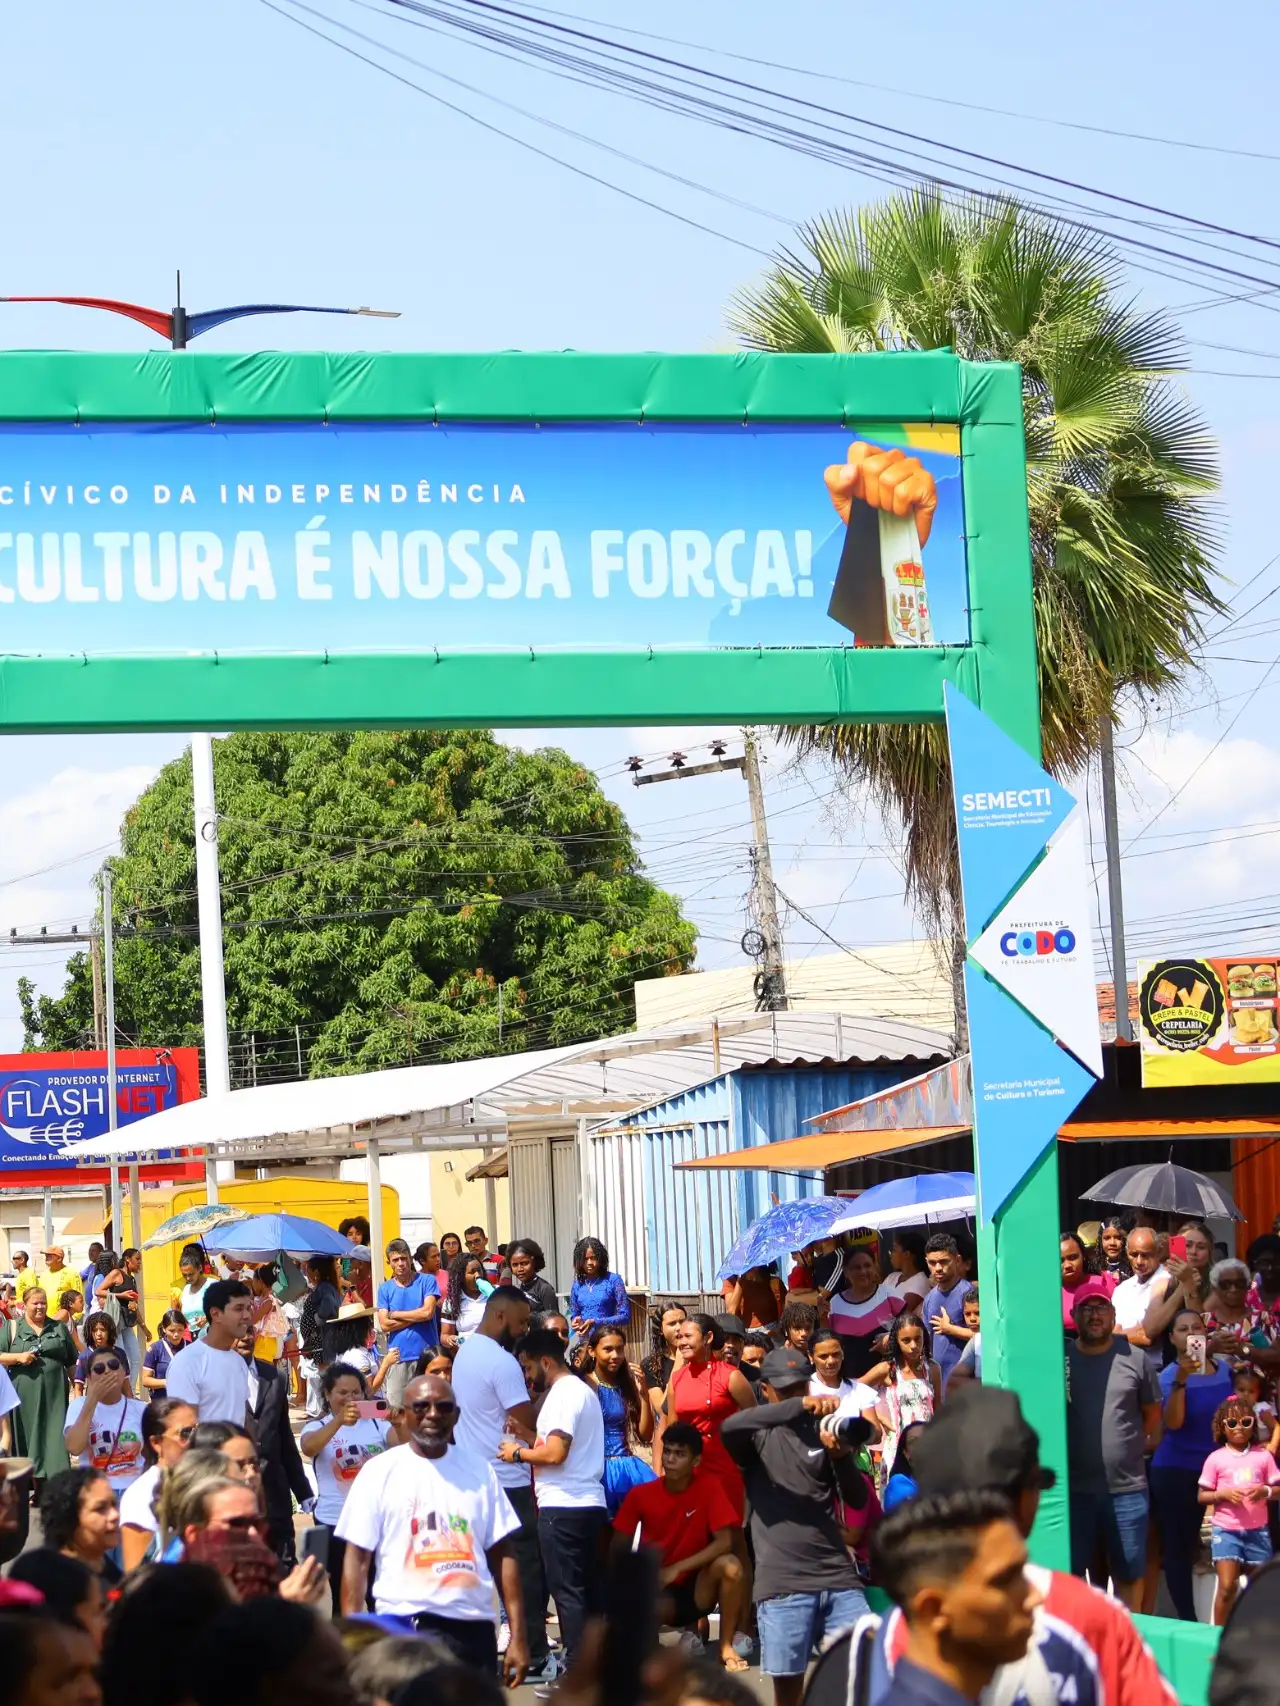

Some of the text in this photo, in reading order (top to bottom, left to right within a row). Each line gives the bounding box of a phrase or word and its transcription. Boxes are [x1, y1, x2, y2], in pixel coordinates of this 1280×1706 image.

[154, 484, 196, 504] DA
[220, 479, 526, 504] INDEPENDÊNCIA
[294, 514, 333, 600] É
[351, 529, 572, 600] NOSSA
[590, 529, 814, 616] FORÇA!
[962, 788, 1051, 811] SEMECTI
[1000, 925, 1076, 957] CODÓ
[1152, 1009, 1176, 1022] CREPE
[1184, 1009, 1210, 1022] PASTEL
[1161, 1020, 1203, 1029] CREPELARIA
[48, 1075, 98, 1086] PROVEDOR
[116, 1073, 160, 1083] NTERNET
[983, 1077, 1060, 1091] Secretaria Municipal
[984, 1093, 994, 1101] de
[996, 1091, 1025, 1099] Cultura
[1033, 1088, 1065, 1097] Turismo
[7, 1087, 104, 1118] FLASH
[1, 1154, 47, 1162] Conectando
